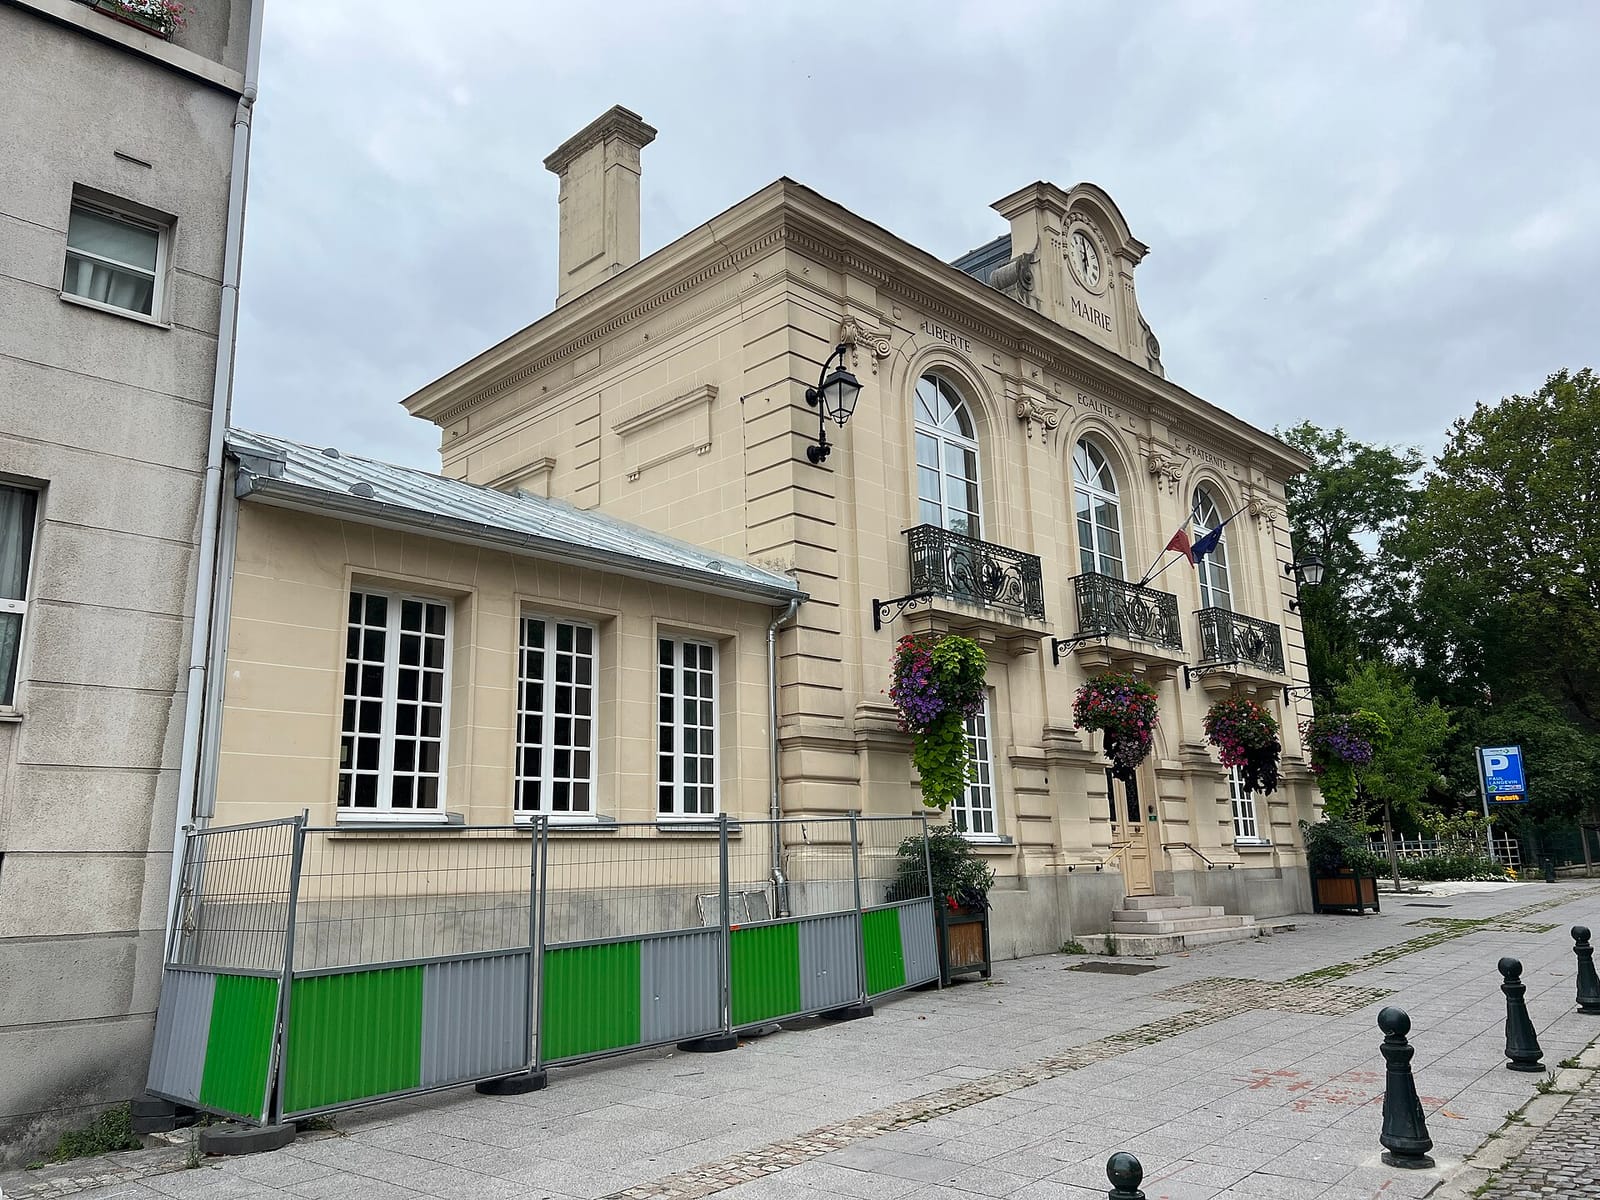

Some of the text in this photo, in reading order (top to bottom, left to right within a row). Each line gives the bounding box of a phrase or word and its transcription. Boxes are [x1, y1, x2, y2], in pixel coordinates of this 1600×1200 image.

[1070, 295, 1112, 332] MAIRIE
[925, 320, 972, 353] LIBERTE
[1077, 393, 1114, 418] EGALITE
[1484, 755, 1509, 776] P
